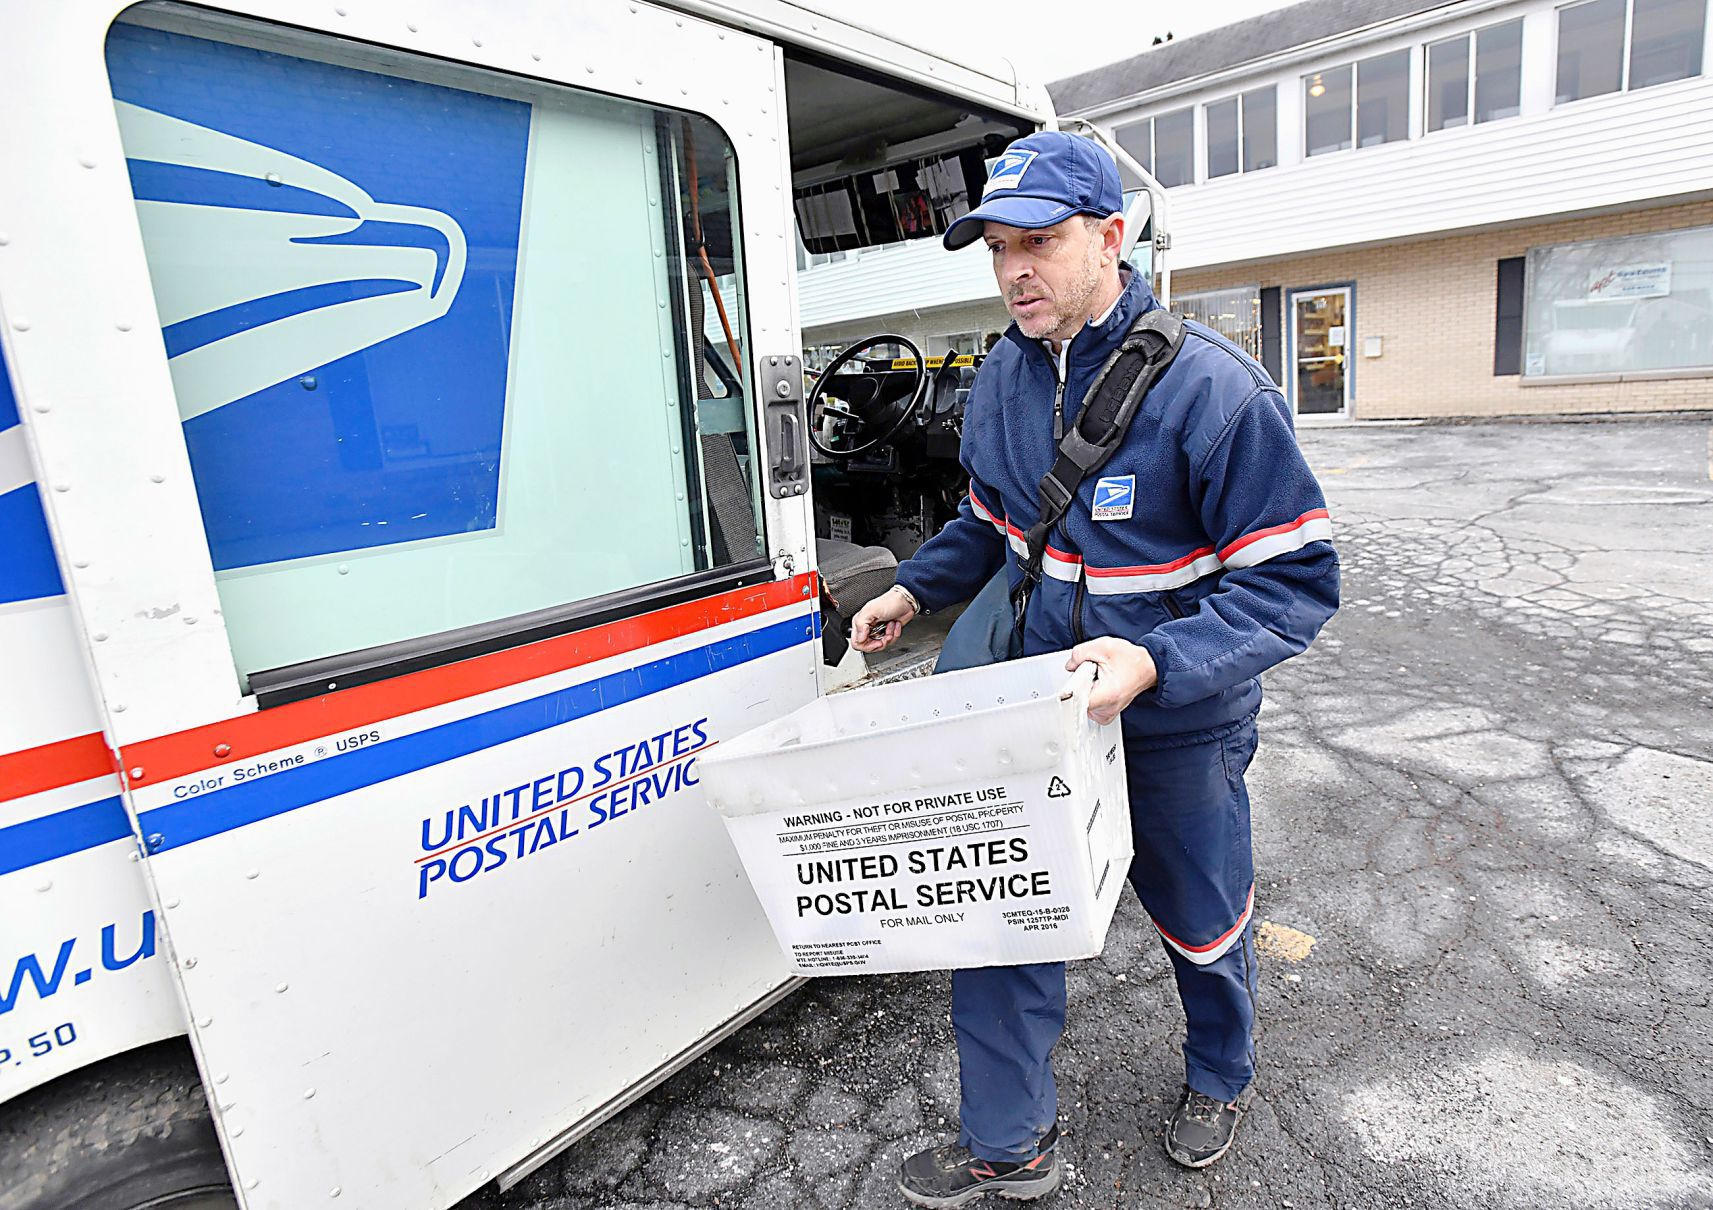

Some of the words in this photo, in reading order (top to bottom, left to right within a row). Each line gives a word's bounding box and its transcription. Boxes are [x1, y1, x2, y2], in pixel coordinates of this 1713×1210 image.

[174, 776, 224, 798] Color
[233, 754, 305, 781] Scheme
[336, 730, 380, 752] USPS
[421, 766, 584, 851] UNITED
[592, 717, 708, 789] STATES
[778, 832, 813, 844] MAXIMUM
[813, 829, 845, 840] PENALTY
[845, 827, 862, 836] FOR
[863, 823, 887, 834] THEFT
[888, 821, 901, 831] OR
[901, 818, 932, 829] MISUSE
[932, 816, 943, 825] OF
[945, 812, 978, 823] POSTAL
[978, 805, 1024, 819] PROPERTY
[783, 811, 843, 828] WARNING
[853, 805, 879, 820] NOT
[883, 801, 913, 816] FOR
[915, 792, 974, 811] PRIVATE
[976, 787, 1007, 802] USE
[418, 810, 579, 900] POSTAL
[588, 757, 700, 830] SERVIC
[799, 842, 822, 852] $1,000
[822, 840, 839, 849] FINE
[839, 838, 855, 847] AND
[861, 835, 887, 844] YEARS
[887, 827, 948, 842] IMPRISONMENT
[949, 825, 961, 835] (18
[962, 822, 980, 832] USC
[982, 819, 1004, 830] 1707)
[797, 854, 898, 885] UNITED
[908, 837, 1028, 875] STATES
[797, 888, 908, 917] POSTAL
[916, 871, 1051, 908] SERVICE
[880, 918, 904, 929] FOR
[905, 915, 933, 927] MAIL
[934, 912, 965, 924] ONLY
[1040, 922, 1058, 931] 2016
[28, 1022, 77, 1057] 50
